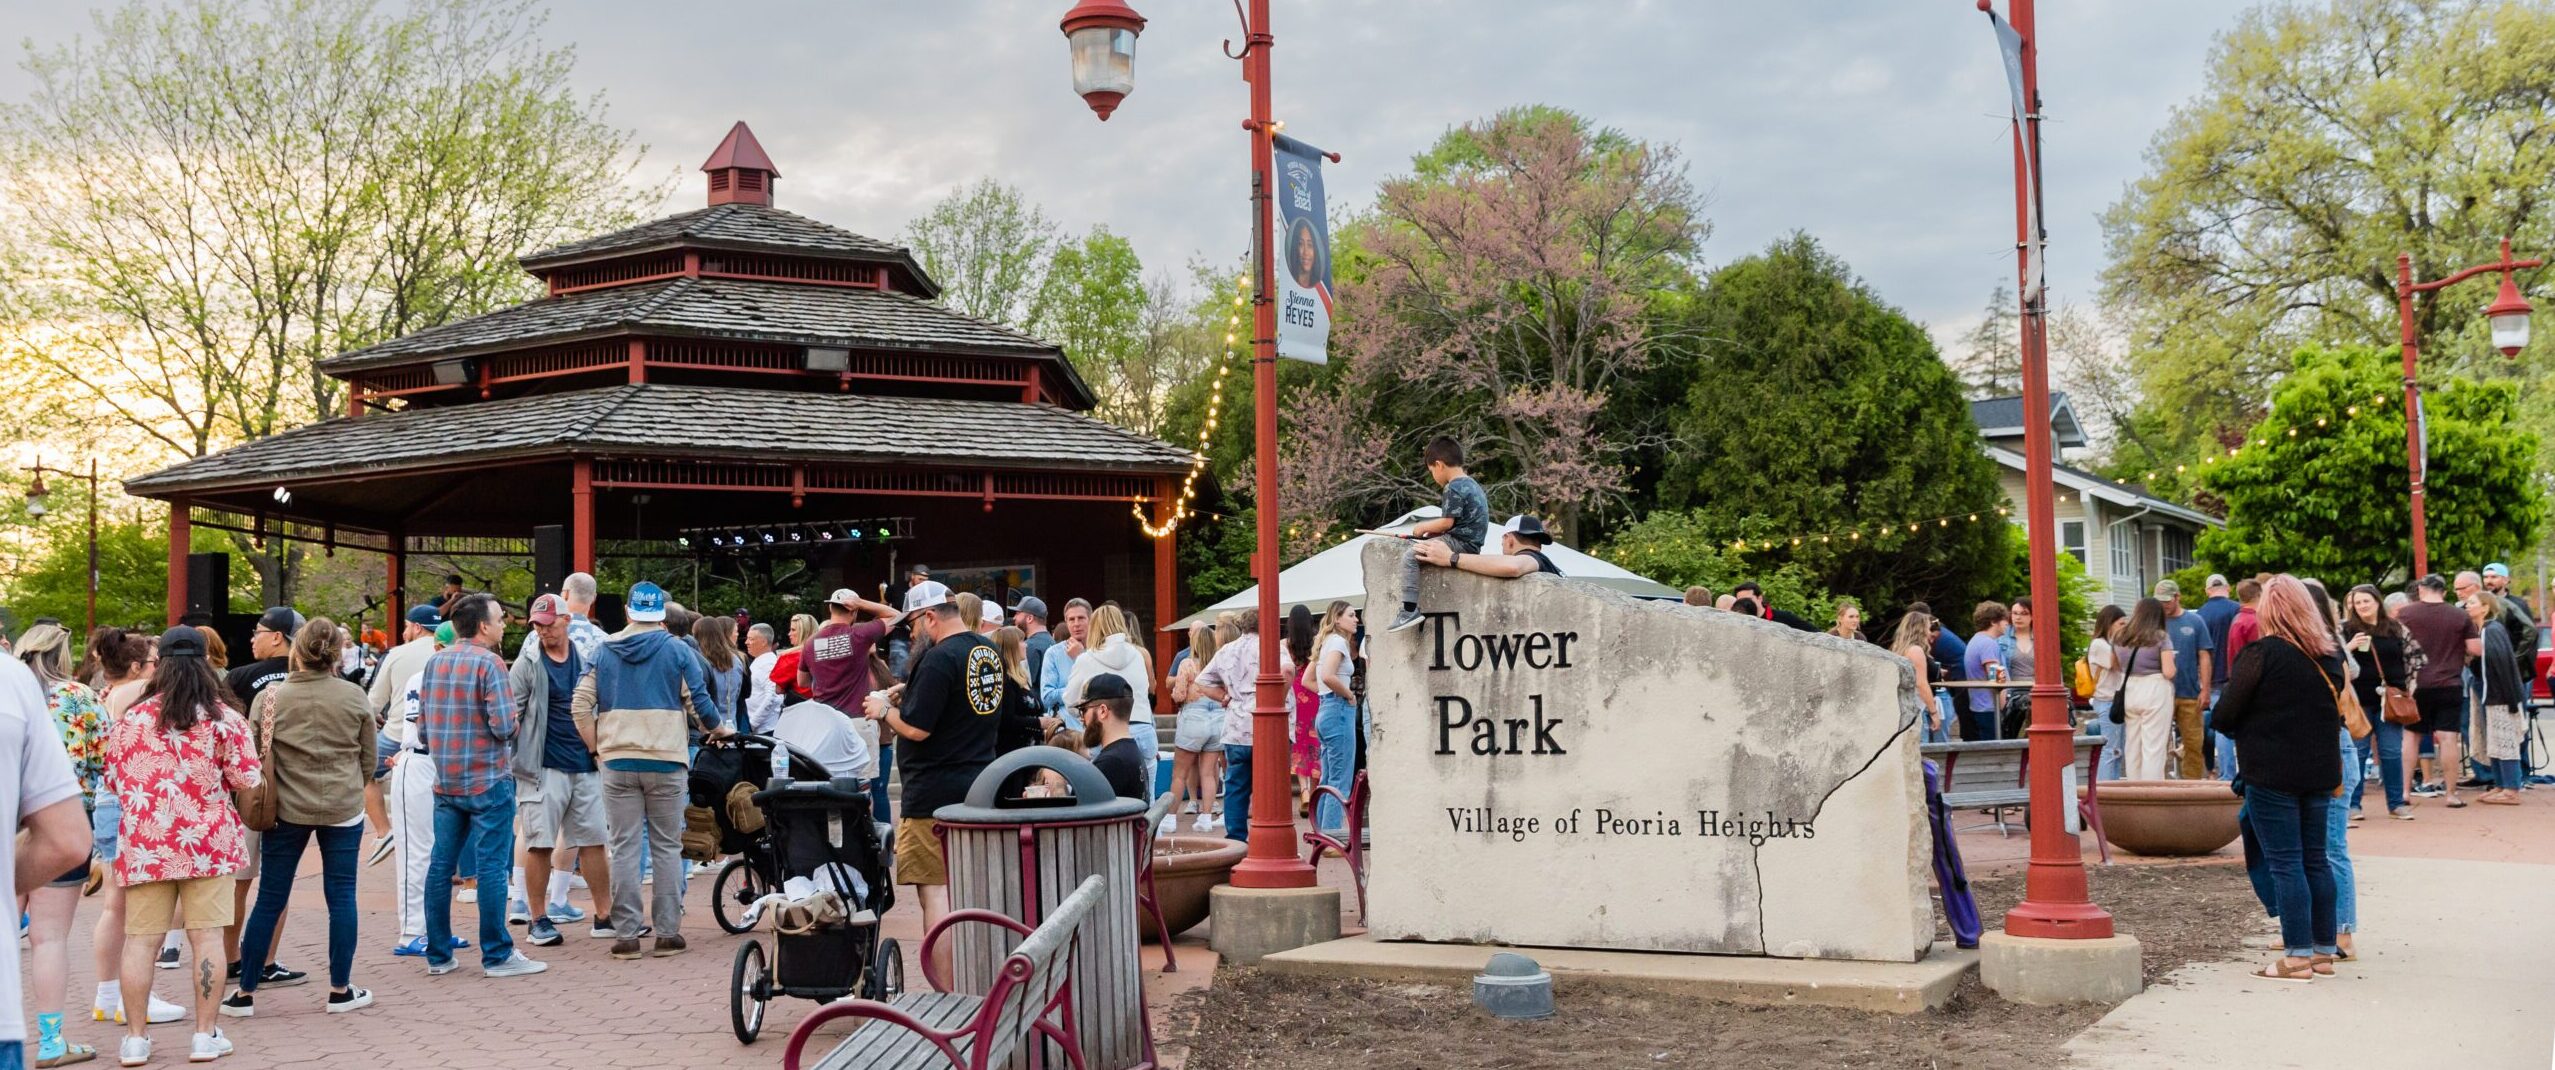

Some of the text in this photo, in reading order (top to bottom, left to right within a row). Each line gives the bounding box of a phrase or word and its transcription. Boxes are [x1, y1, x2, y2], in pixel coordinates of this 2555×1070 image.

[1286, 290, 1315, 307] Sienna
[1285, 305, 1314, 328] REYES
[1419, 612, 1578, 671] Tower
[970, 658, 979, 676] THE
[1434, 694, 1567, 755] Park
[1446, 808, 1815, 846] Village of Peoria Heights
